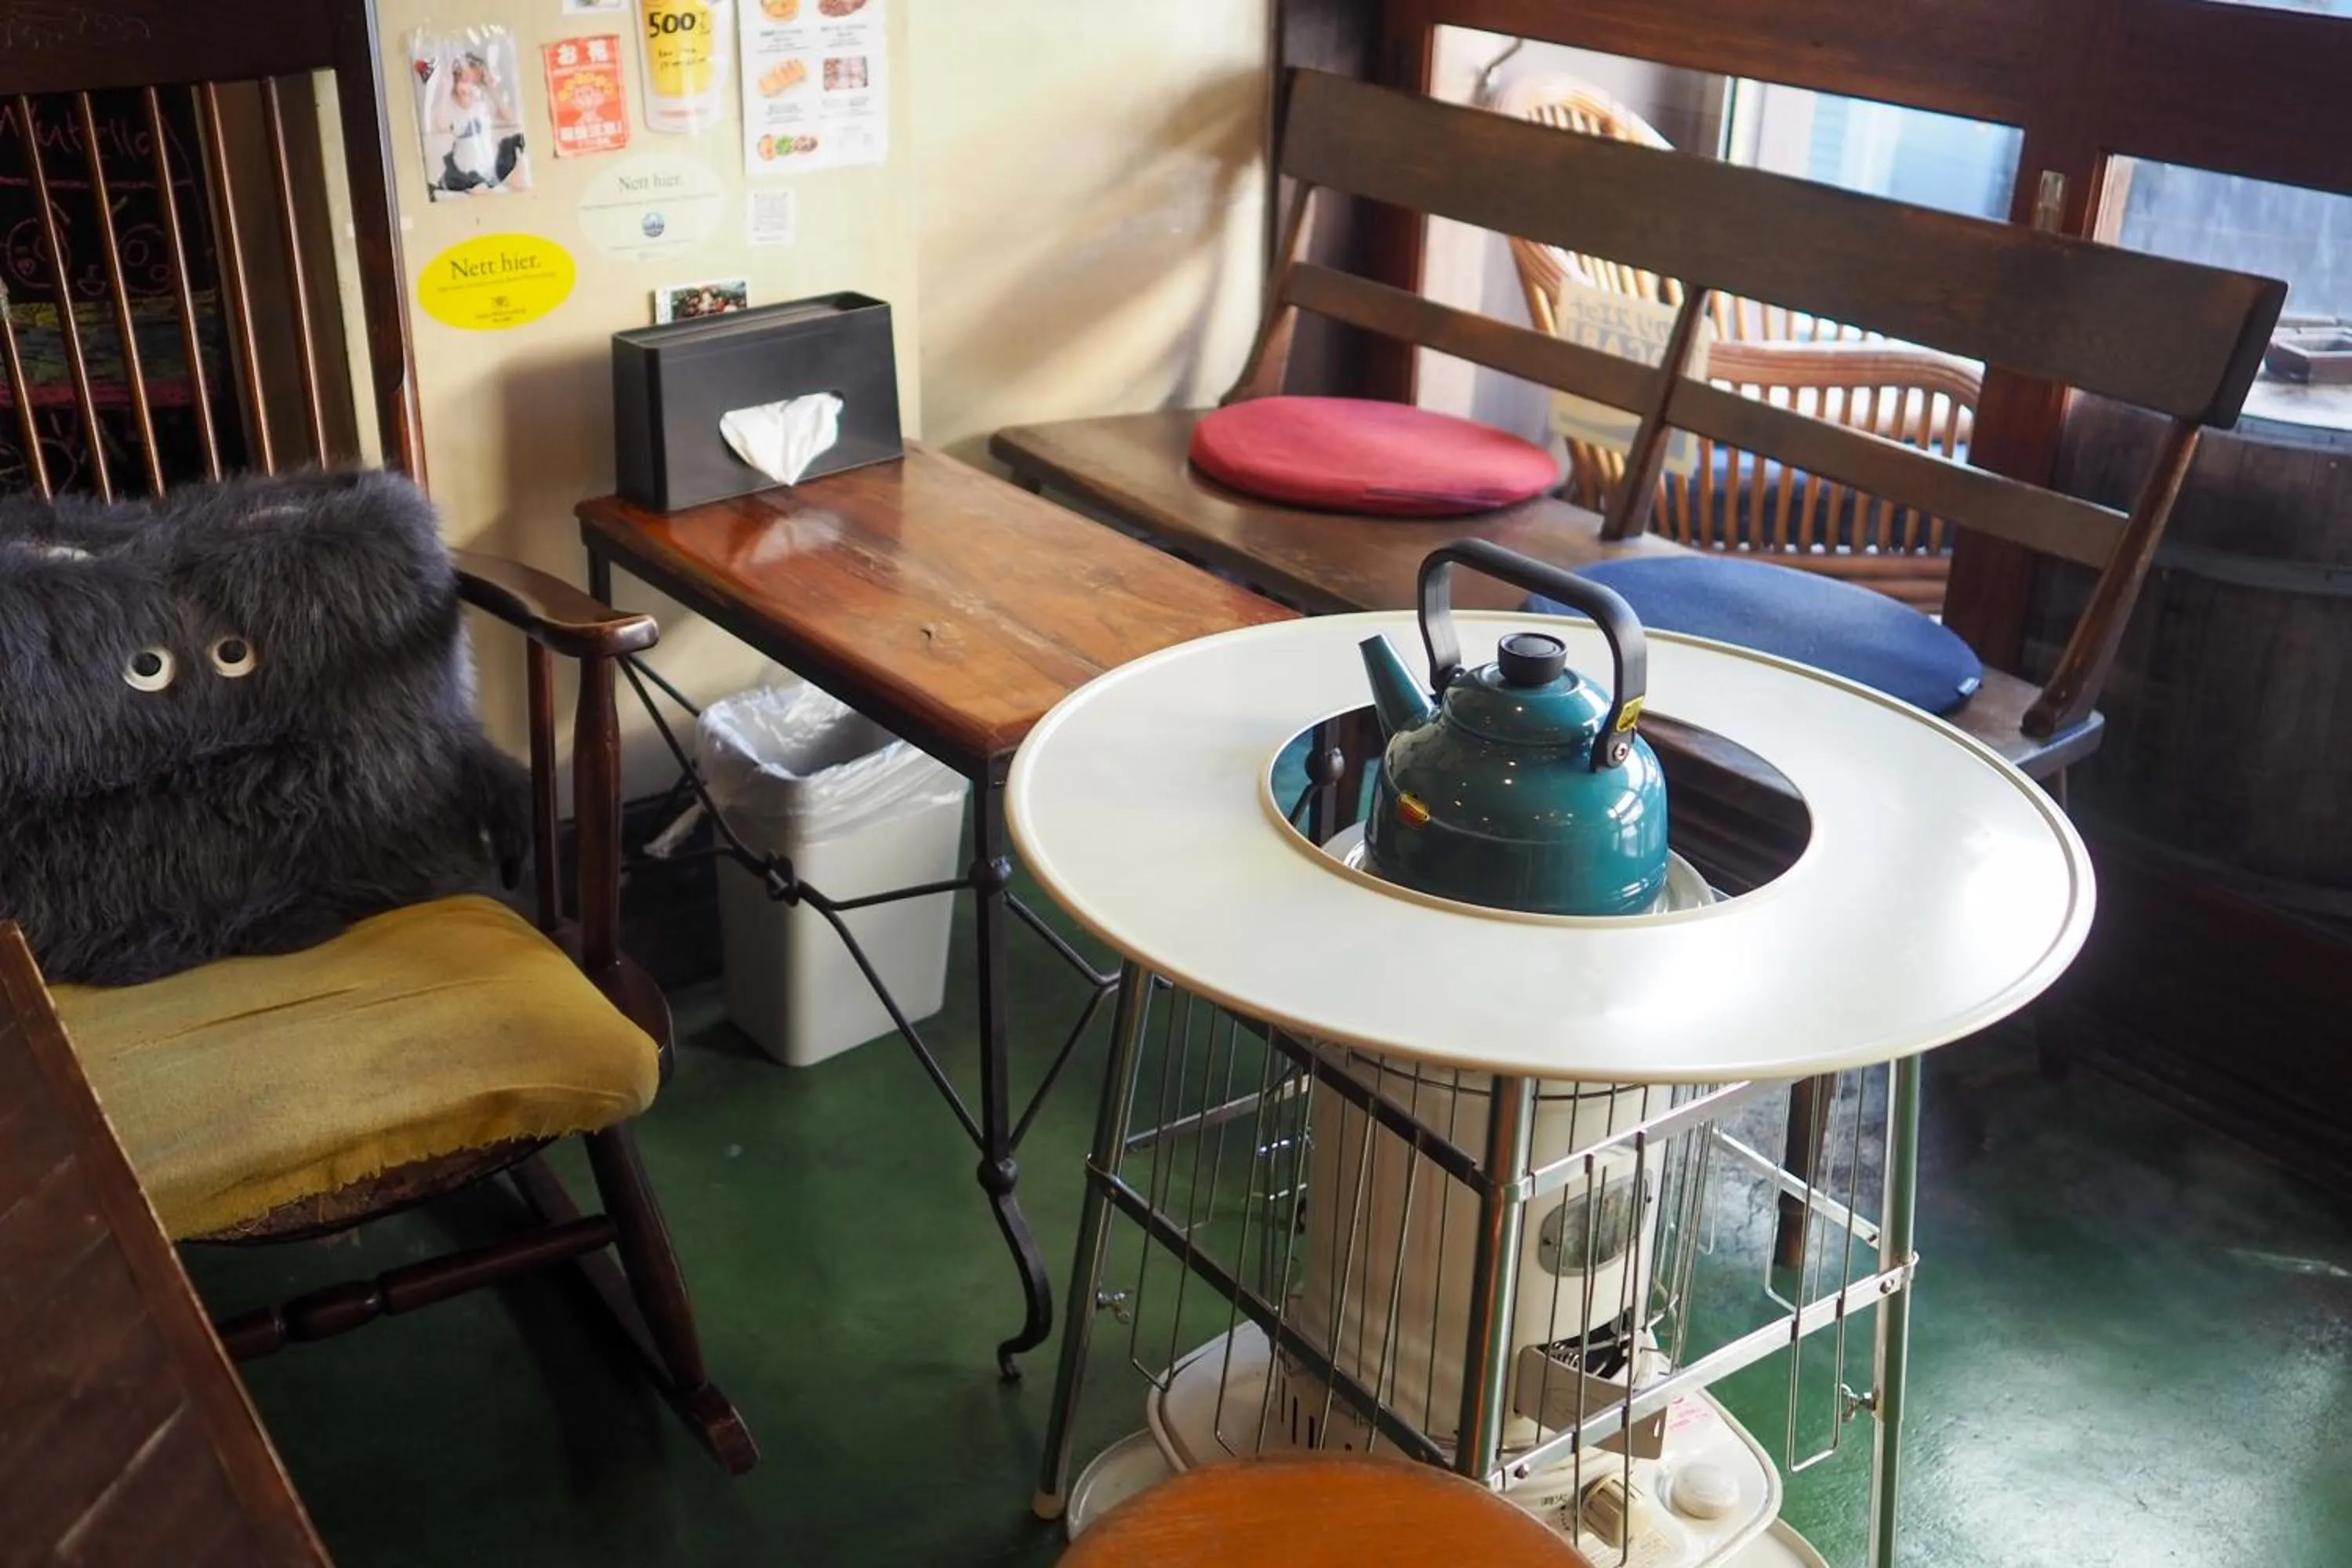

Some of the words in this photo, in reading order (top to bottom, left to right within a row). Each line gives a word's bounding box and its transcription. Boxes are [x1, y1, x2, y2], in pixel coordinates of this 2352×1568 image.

[648, 12, 696, 38] 500
[616, 174, 649, 193] Nett
[450, 257, 496, 280] Nett
[500, 251, 542, 273] hier.
